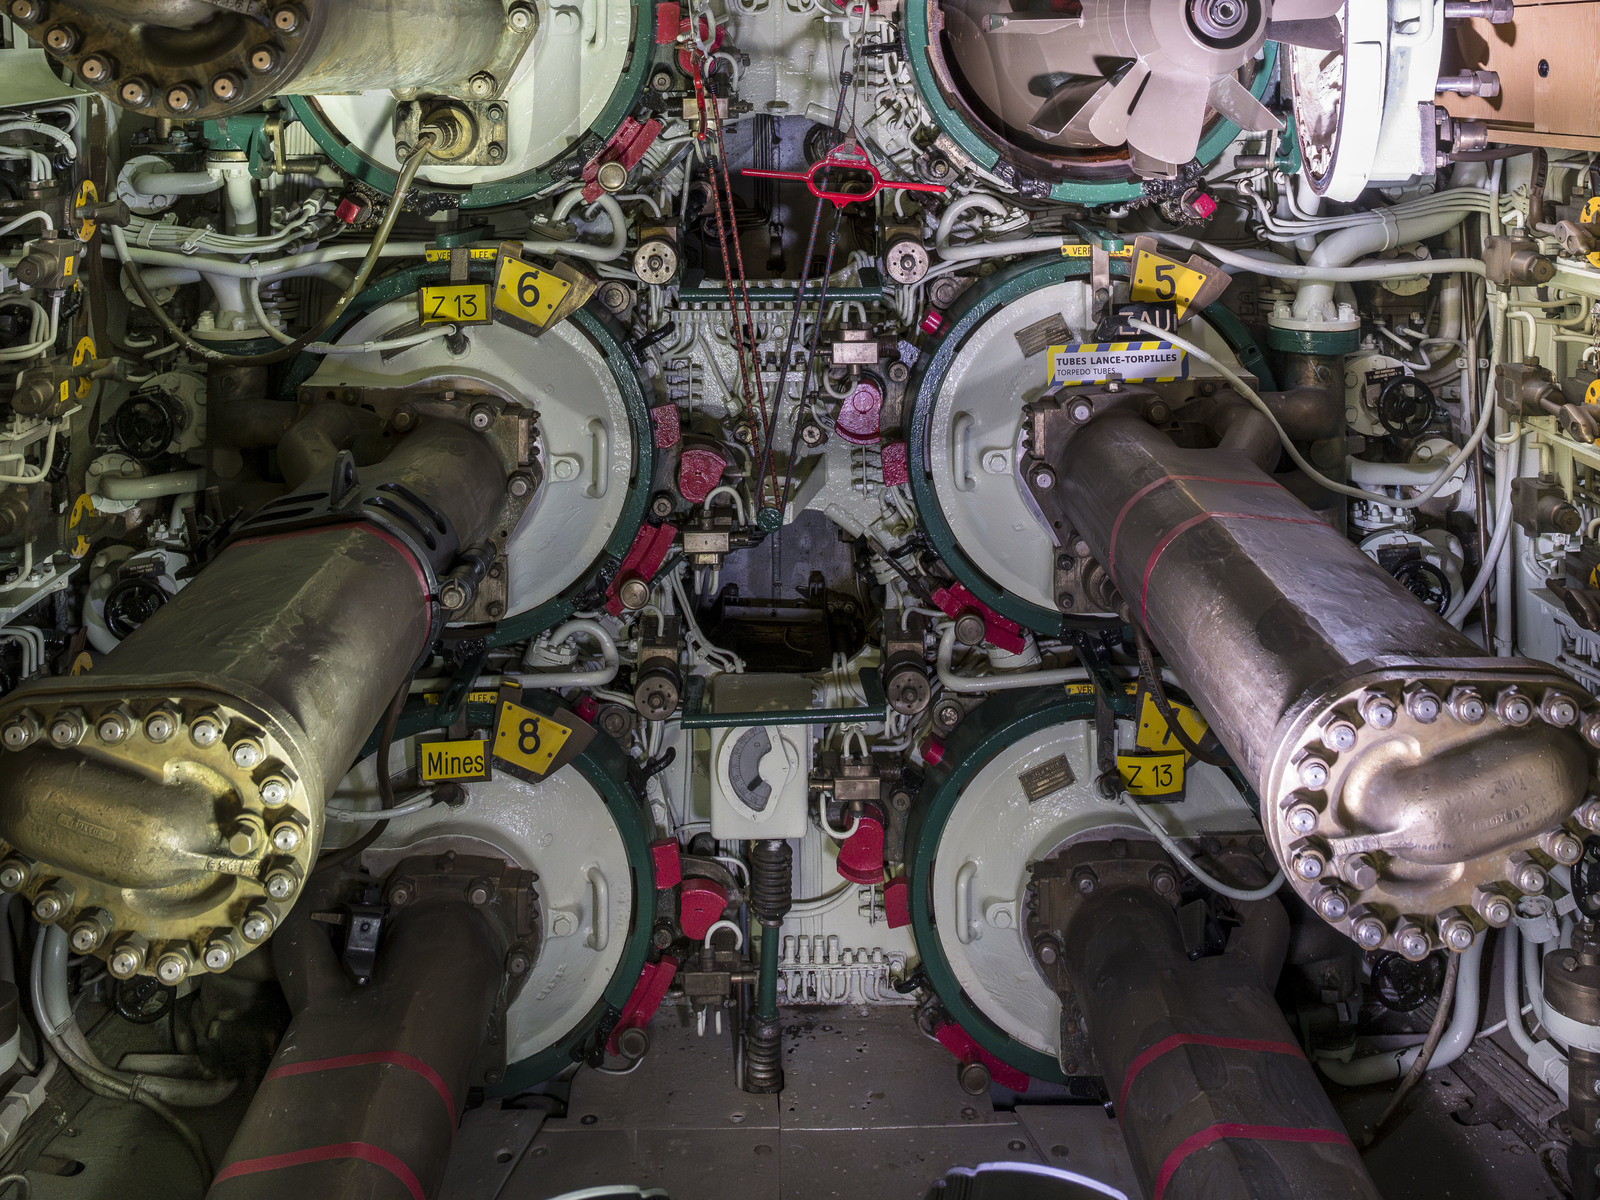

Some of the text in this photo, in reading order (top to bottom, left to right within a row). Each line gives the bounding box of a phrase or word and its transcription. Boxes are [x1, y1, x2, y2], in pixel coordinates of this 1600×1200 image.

[517, 271, 540, 307] 6
[1155, 264, 1176, 300] 5
[431, 294, 477, 319] Z 13
[1056, 354, 1177, 366] TUBES LANCE-TORPILLES
[1057, 367, 1116, 376] TORPEDO TUBES
[517, 717, 541, 755] 8
[428, 751, 484, 776] Mines
[1127, 764, 1173, 788] Z 13
